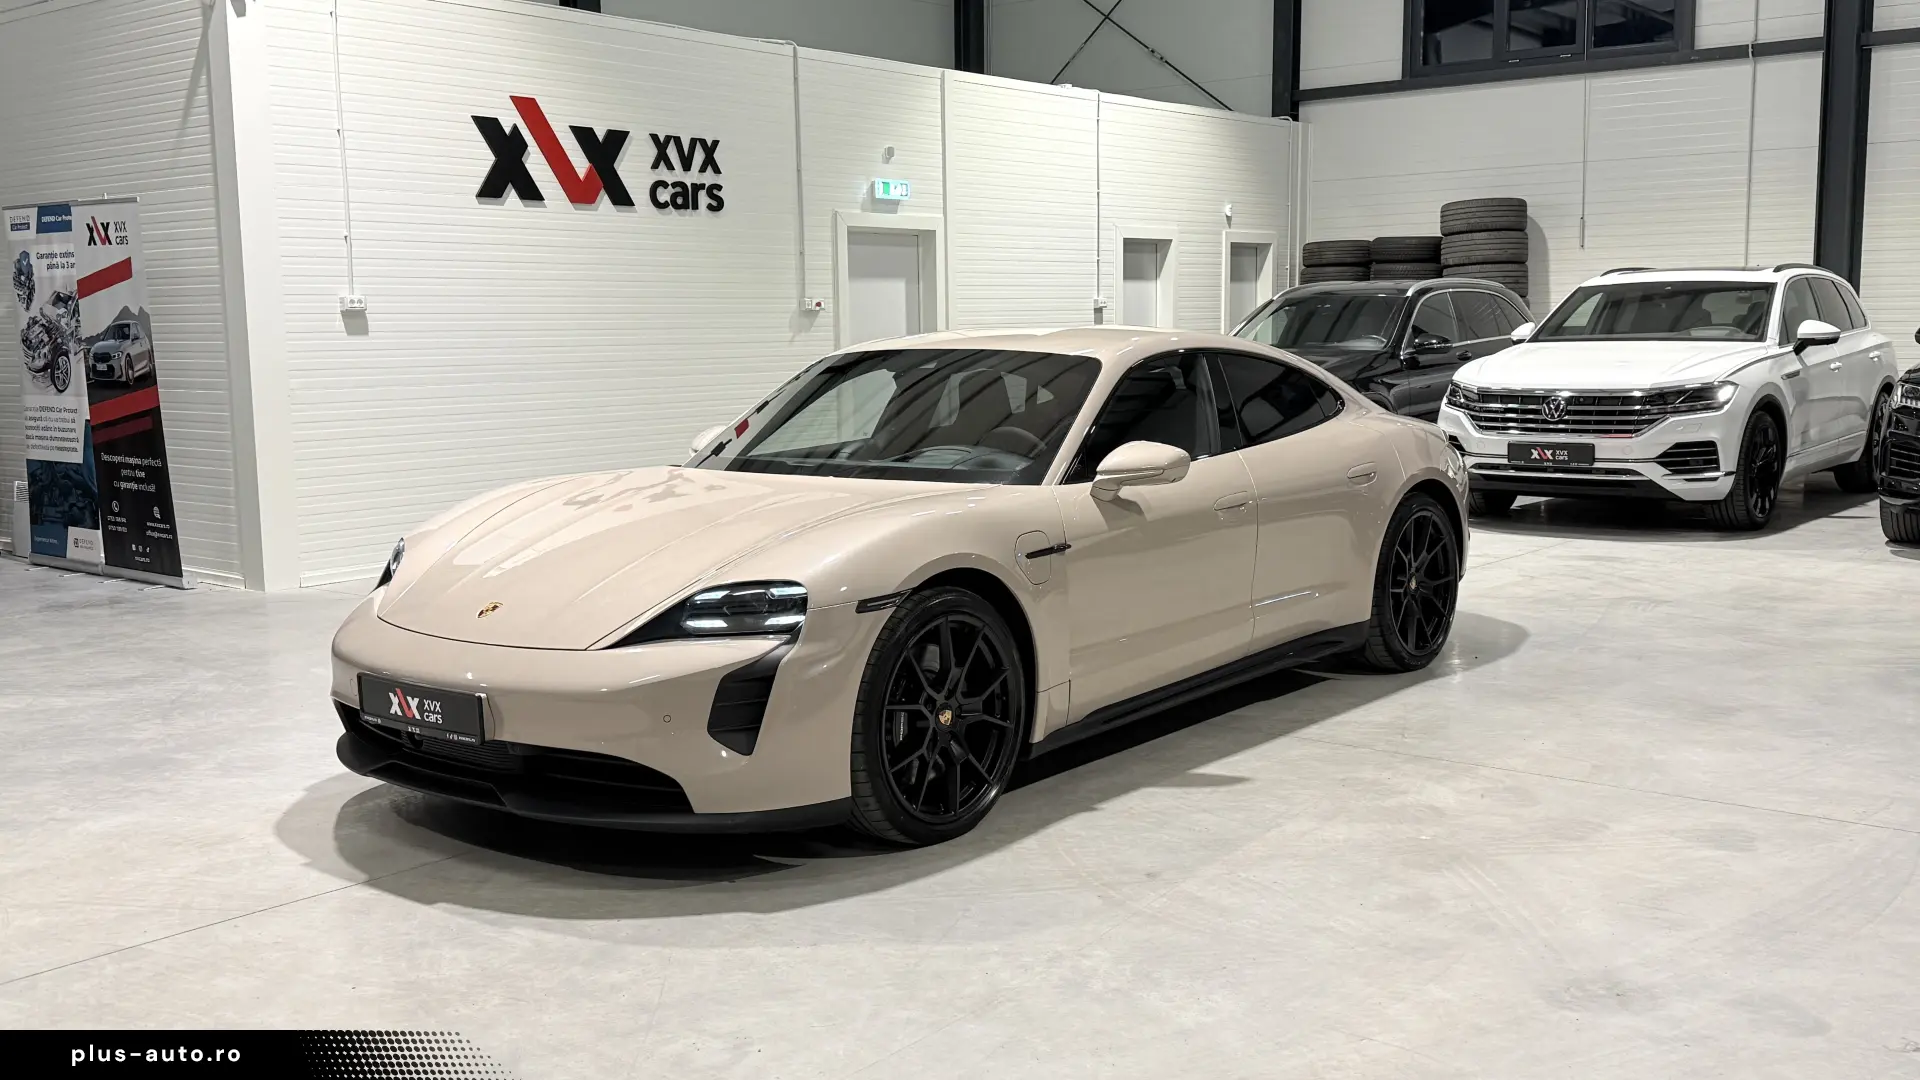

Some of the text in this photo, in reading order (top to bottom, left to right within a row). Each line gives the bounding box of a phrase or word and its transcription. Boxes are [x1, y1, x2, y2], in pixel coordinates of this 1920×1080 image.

[648, 133, 722, 174] XVX
[649, 179, 724, 212] cars
[113, 220, 128, 234] XVX
[115, 234, 129, 246] cars
[423, 699, 441, 712] XVX
[423, 711, 443, 724] cars
